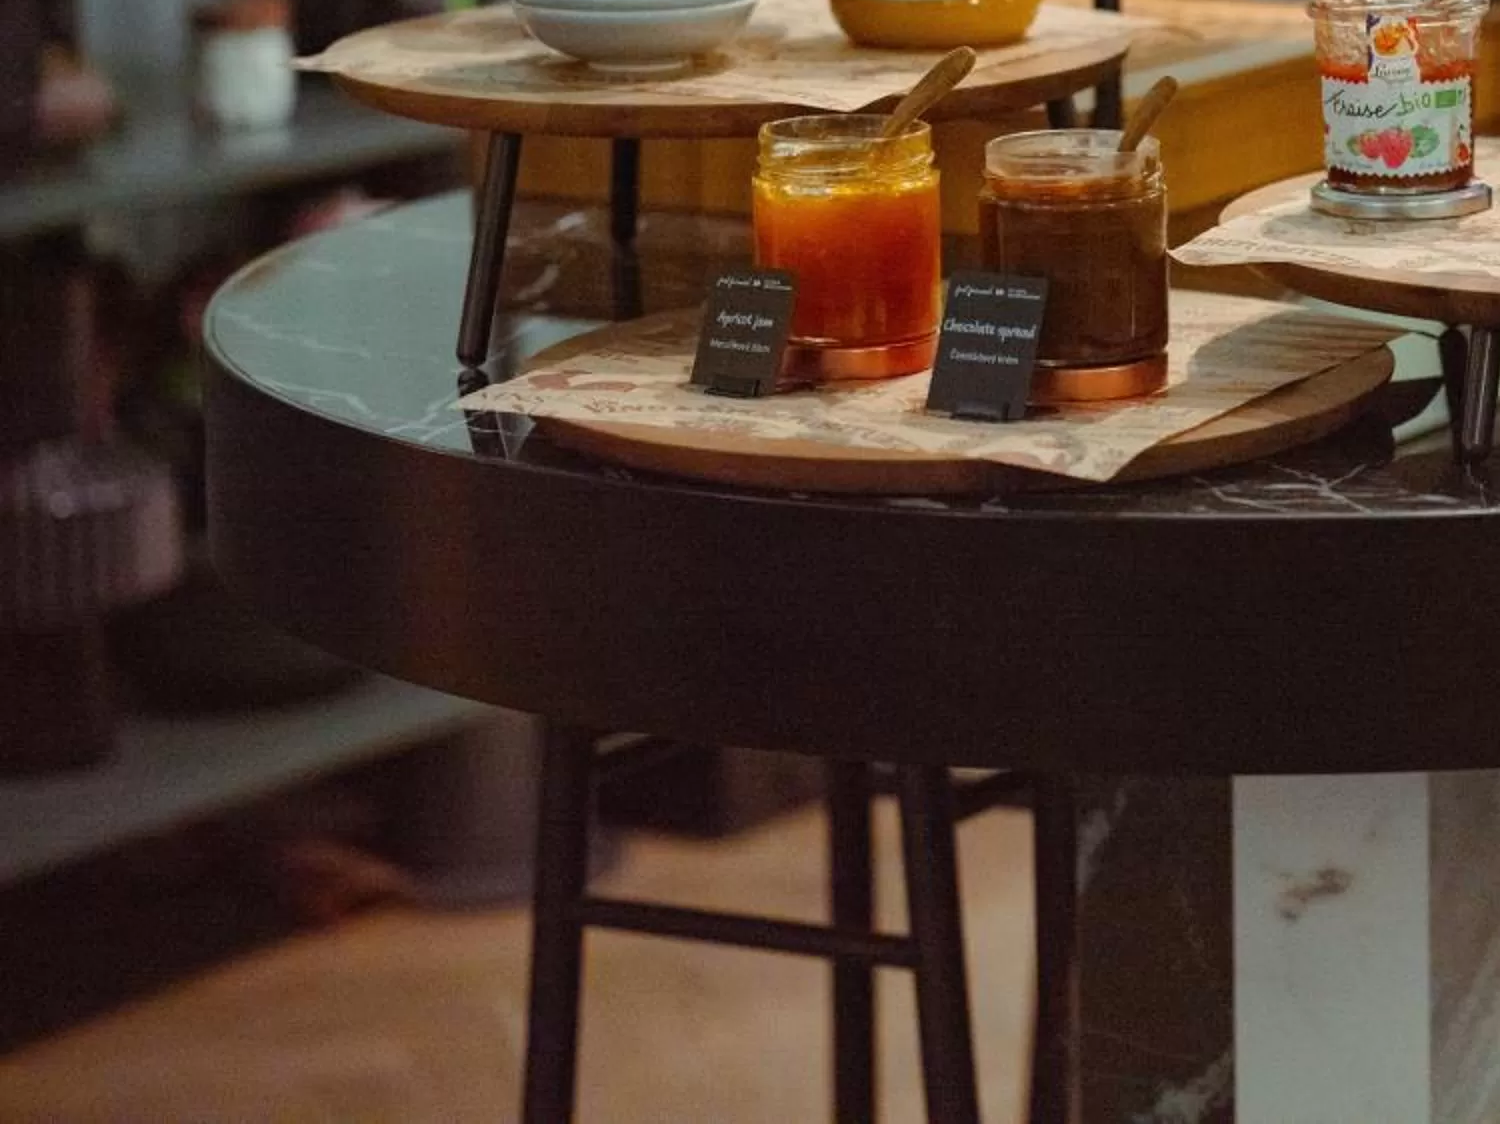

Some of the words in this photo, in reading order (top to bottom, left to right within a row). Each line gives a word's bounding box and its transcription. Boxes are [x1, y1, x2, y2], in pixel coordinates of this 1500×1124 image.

[1326, 89, 1397, 118] Fraise
[1396, 91, 1431, 116] bio
[716, 309, 752, 329] Apricot
[751, 314, 774, 331] jam
[943, 317, 996, 335] Chocolate
[997, 323, 1037, 342] spread
